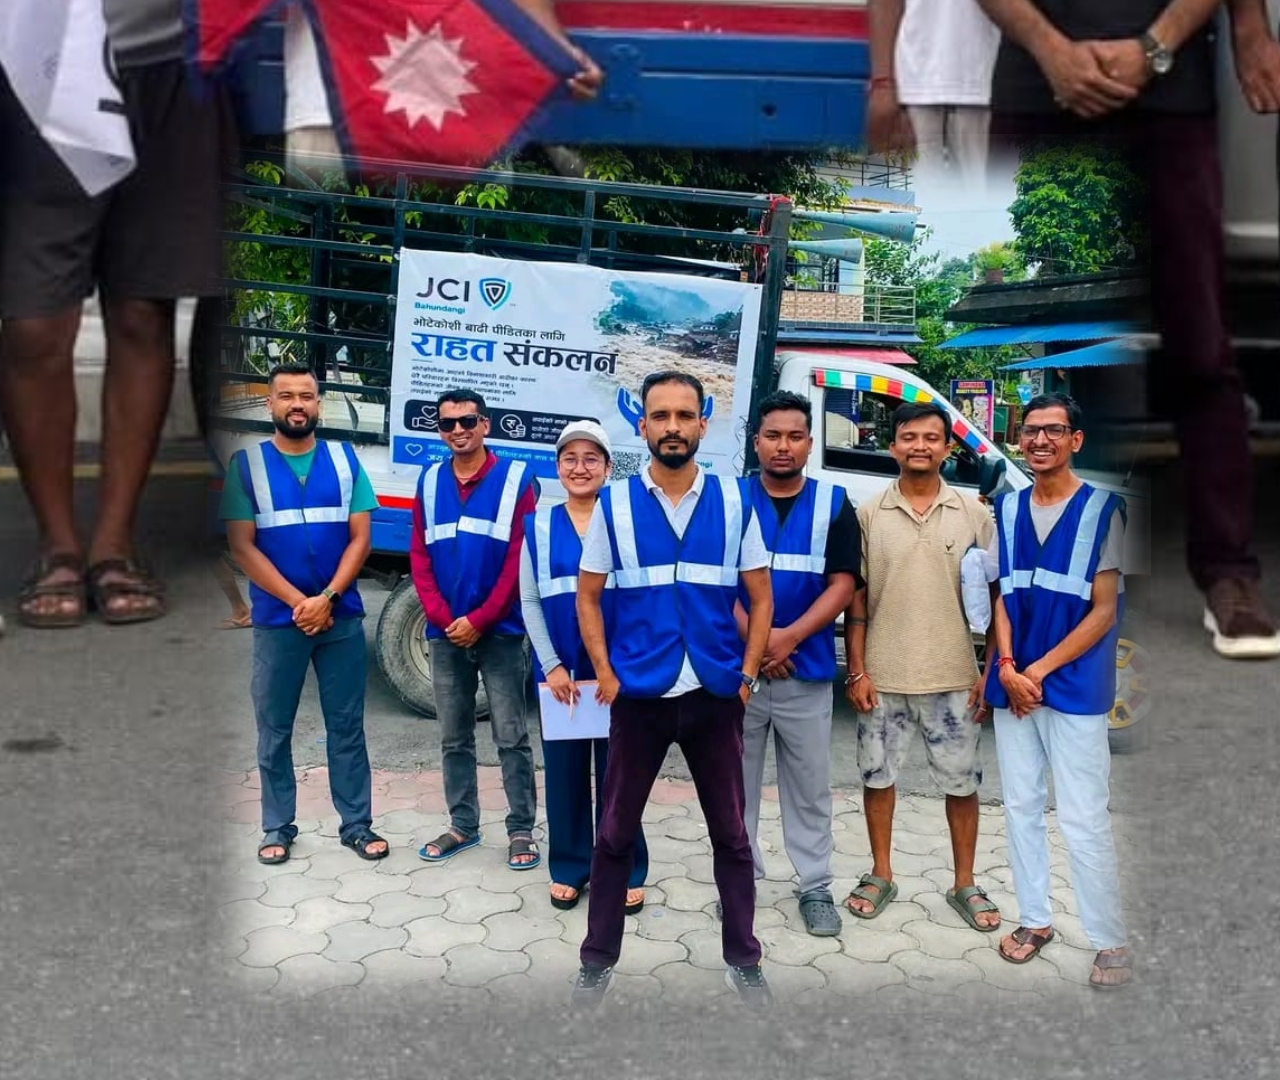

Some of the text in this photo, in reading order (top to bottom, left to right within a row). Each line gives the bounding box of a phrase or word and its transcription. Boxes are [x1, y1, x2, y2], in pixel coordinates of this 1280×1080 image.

[416, 277, 470, 302] JCI
[414, 302, 466, 314] Bahundangi
[413, 316, 566, 342] भोटेकोशी बाढी पीडितका लागि
[411, 332, 619, 374] राहत संकलन
